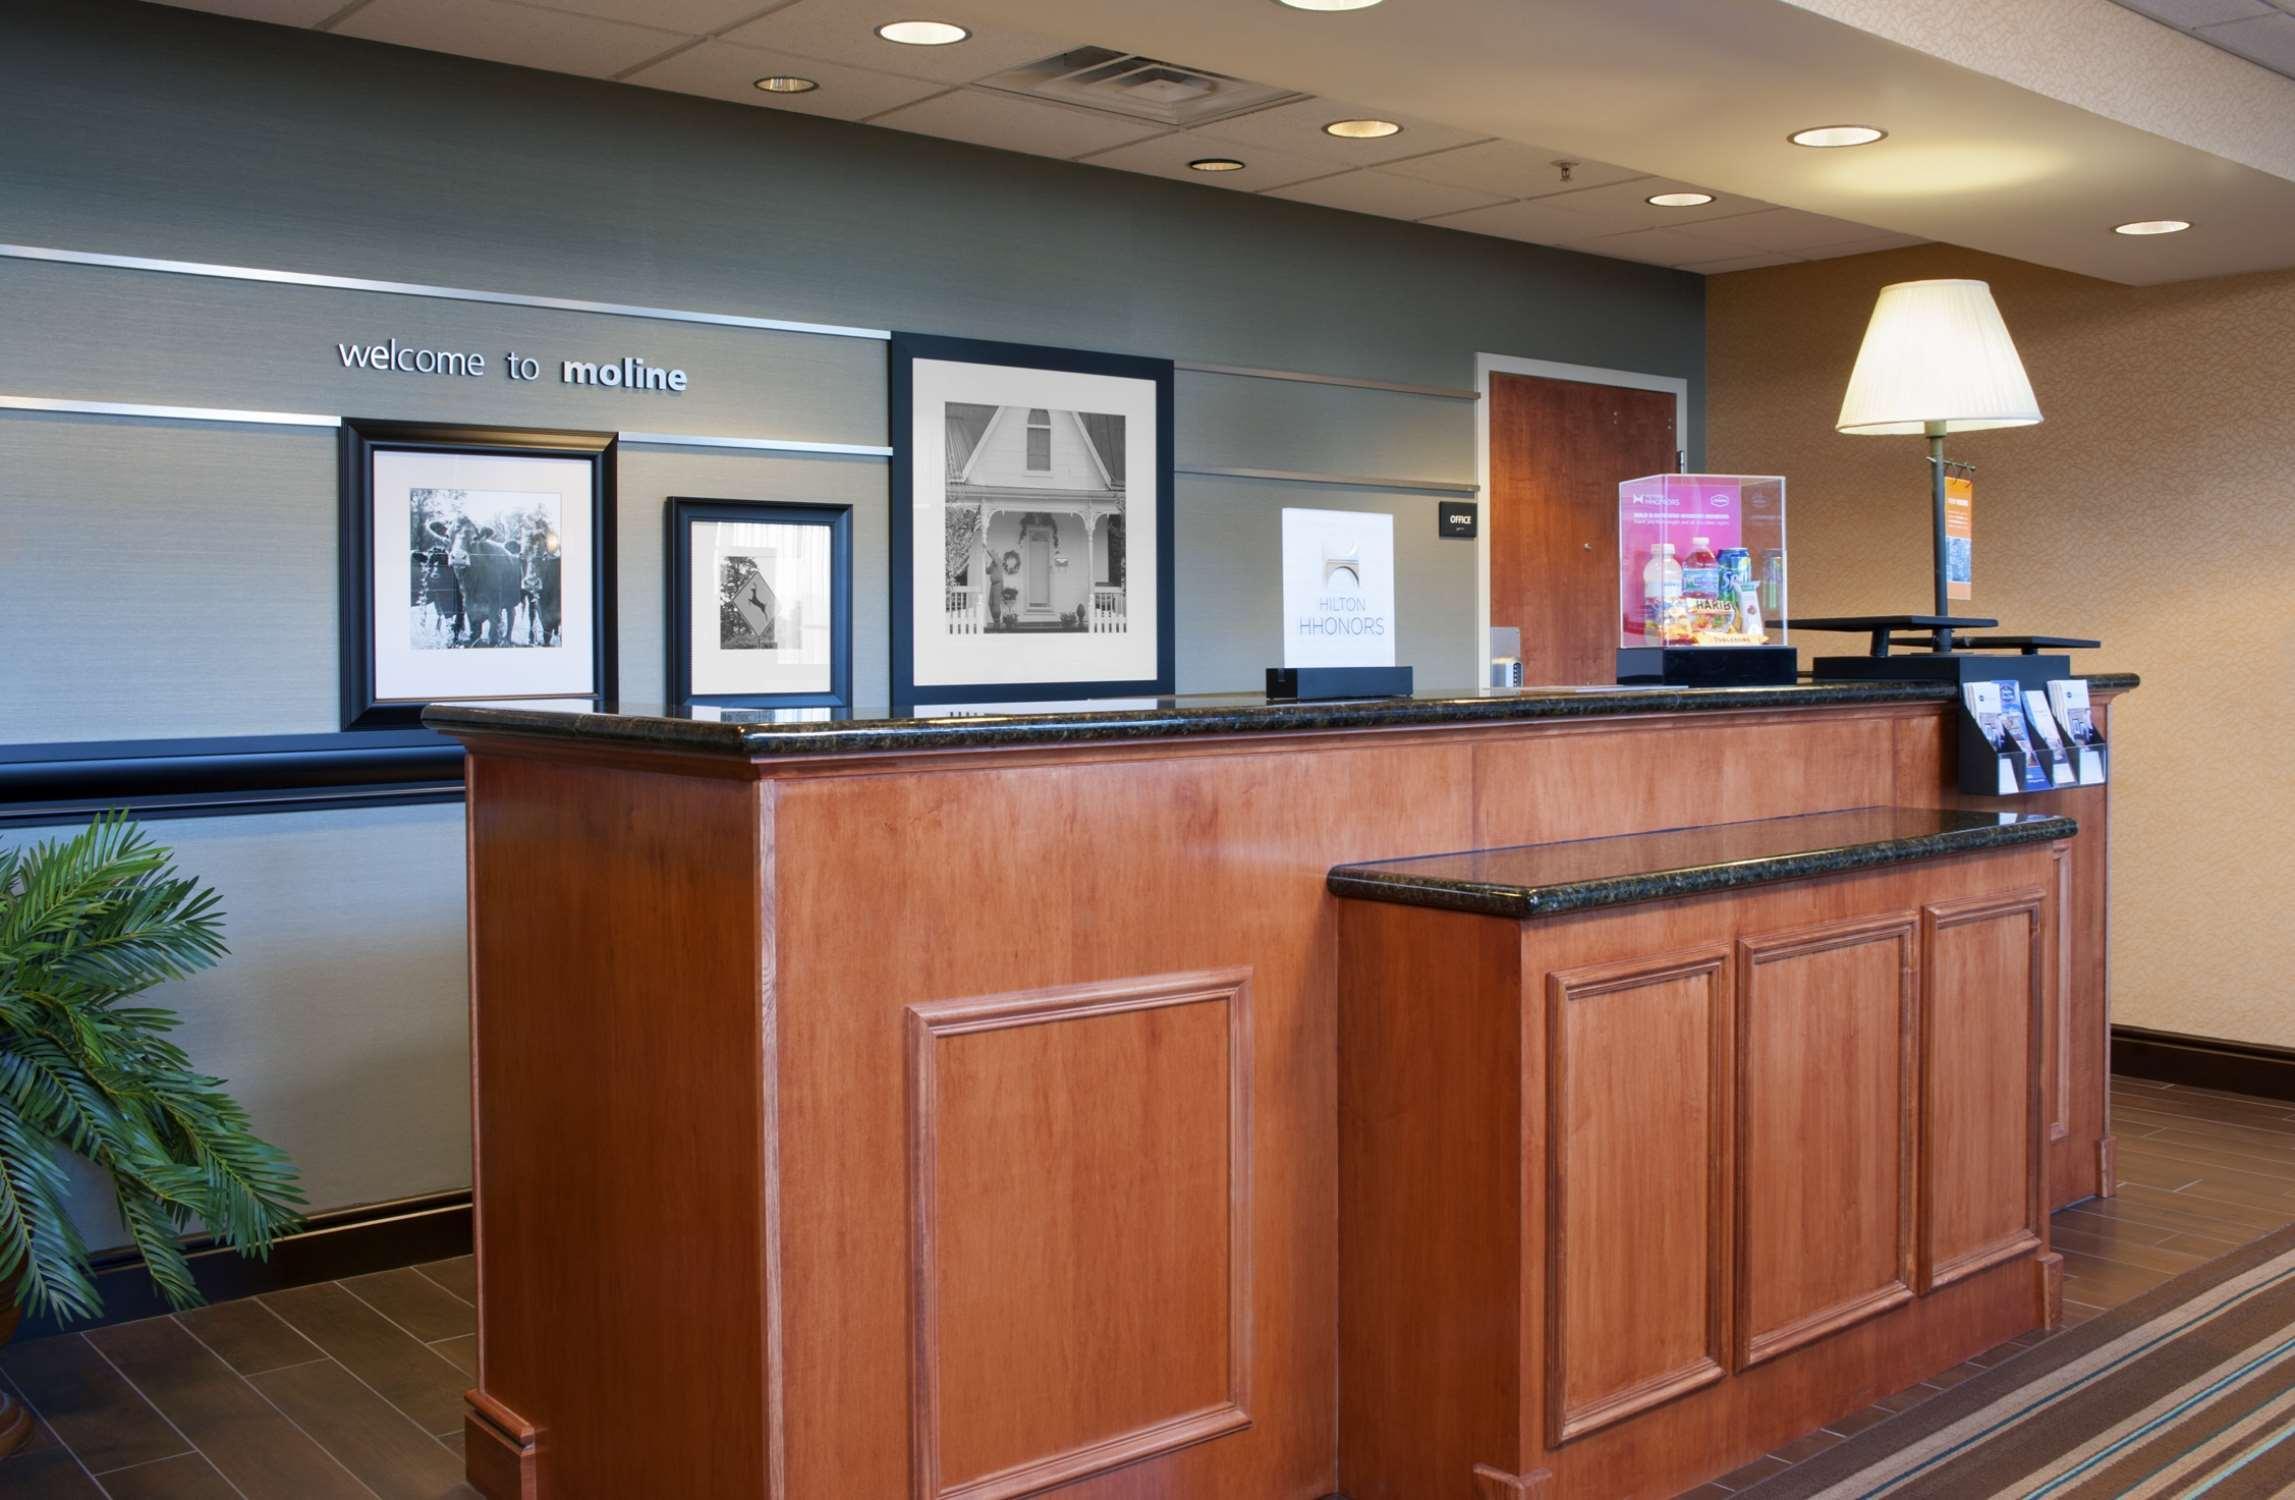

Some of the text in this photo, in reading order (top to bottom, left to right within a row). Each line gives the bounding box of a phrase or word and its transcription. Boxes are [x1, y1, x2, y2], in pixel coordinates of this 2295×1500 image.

[338, 338, 688, 391] welcome to moline
[1449, 514, 1472, 525] OFFICE
[1319, 597, 1366, 611] HILTON
[1696, 599, 1732, 611] HARIB
[1299, 616, 1385, 636] HHONORS
